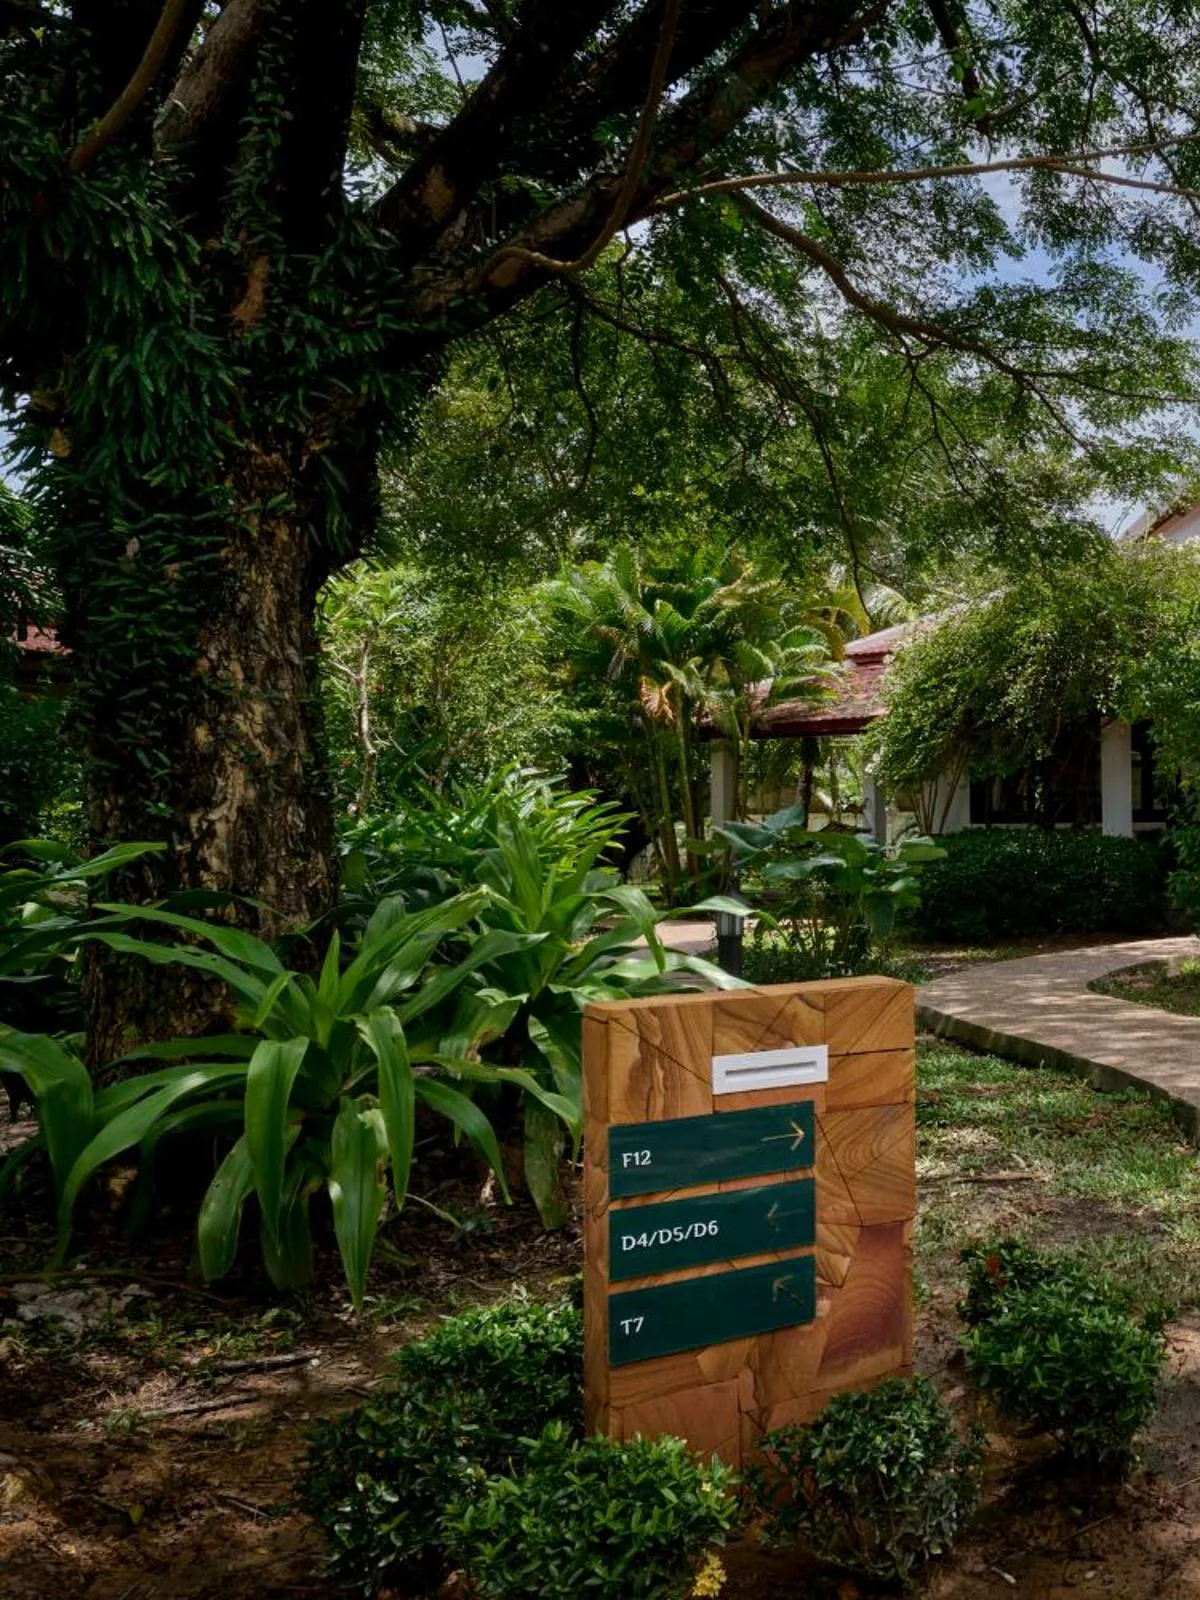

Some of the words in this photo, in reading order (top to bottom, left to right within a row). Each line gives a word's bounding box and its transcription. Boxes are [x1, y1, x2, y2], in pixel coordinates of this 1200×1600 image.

[622, 1149, 652, 1168] F12
[621, 1220, 719, 1251] D4/D5/D6
[620, 1316, 645, 1335] T7
